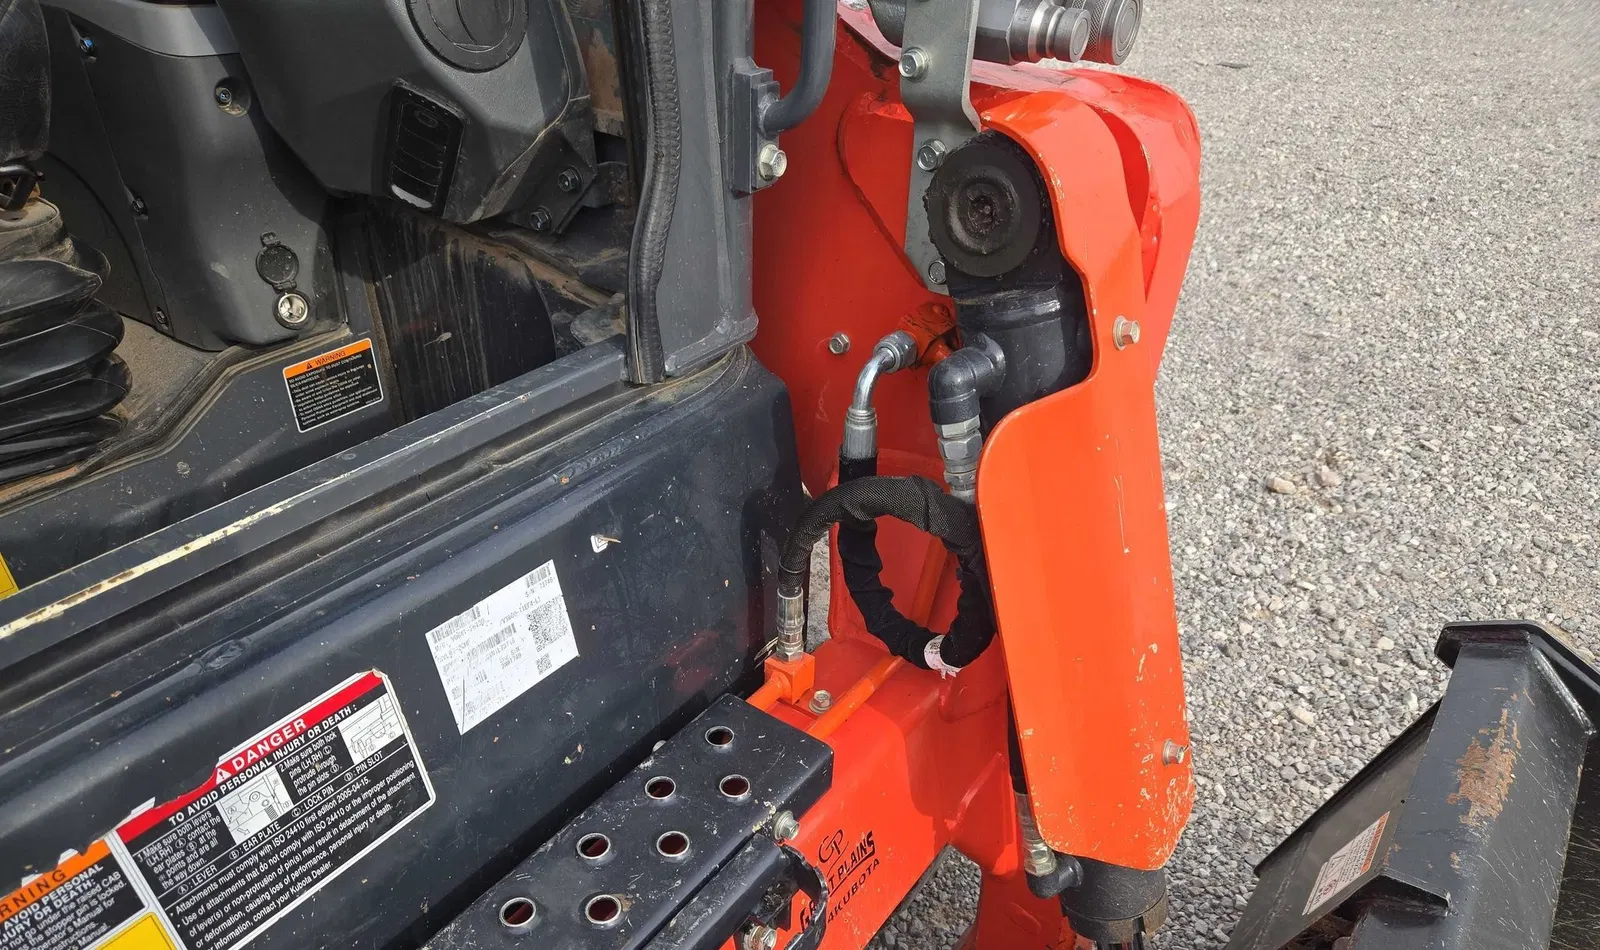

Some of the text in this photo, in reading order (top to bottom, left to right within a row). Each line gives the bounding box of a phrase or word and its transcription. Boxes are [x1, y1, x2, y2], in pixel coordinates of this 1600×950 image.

[315, 350, 345, 365] WARNING
[168, 812, 184, 825] TO
[187, 790, 218, 816] AVOID
[219, 757, 272, 794] PERSONAL
[272, 734, 305, 761] INJURY
[307, 725, 321, 738] OR
[321, 706, 351, 730] DEATH
[230, 717, 308, 772] DANGER
[278, 731, 337, 772] 2.Make sure both lock
[288, 766, 301, 779] pins
[300, 750, 323, 770] (LH,RH)
[293, 768, 316, 789] protrude
[297, 786, 307, 796] the
[306, 779, 317, 791] pin
[316, 771, 330, 784] slots
[146, 844, 173, 867] (LH,RH)
[187, 821, 210, 841] contact
[209, 815, 221, 826] the
[162, 832, 177, 846] sure
[176, 823, 192, 836] both
[191, 810, 212, 827] levers
[181, 760, 414, 926] Use of attachments that do not comply with ISO 24410 or the improper positioning
[191, 864, 217, 886] LEVER
[242, 836, 259, 851] EAR
[257, 820, 281, 841] PLATE
[303, 792, 322, 810] LOCK
[321, 784, 334, 797] PIN
[355, 761, 367, 774] PIN
[366, 750, 383, 767] SLOT
[153, 862, 165, 874] ear
[164, 849, 185, 867] plates
[198, 834, 206, 844] at
[204, 828, 216, 839] the
[165, 836, 218, 878] points and are all
[175, 776, 371, 915] Attachments must comply with ISO 24410 first edition 2005-04-15.
[189, 771, 415, 937] of lever(s) or non-protrusion of pin(s) may result in detachment of the attachment
[837, 830, 876, 880] PLAINS
[4, 864, 103, 930] AVOID PERSONAL
[161, 857, 207, 889] the way down.
[195, 803, 393, 948] or deformation, causing loss of performance, personal injury or death.
[9, 934, 24, 948] not
[24, 927, 37, 940] go
[36, 910, 61, 930] under
[61, 901, 76, 914] the
[76, 883, 102, 904] raised
[101, 871, 121, 887] CAB
[28, 879, 127, 946] the stopper pin is locked.
[34, 905, 52, 920] OR
[53, 879, 95, 908] DEATH:
[72, 904, 103, 928] Manual
[102, 897, 115, 908] for
[213, 860, 333, 950] information, contact your Kubota Dealer.
[77, 922, 110, 947] Manual.
